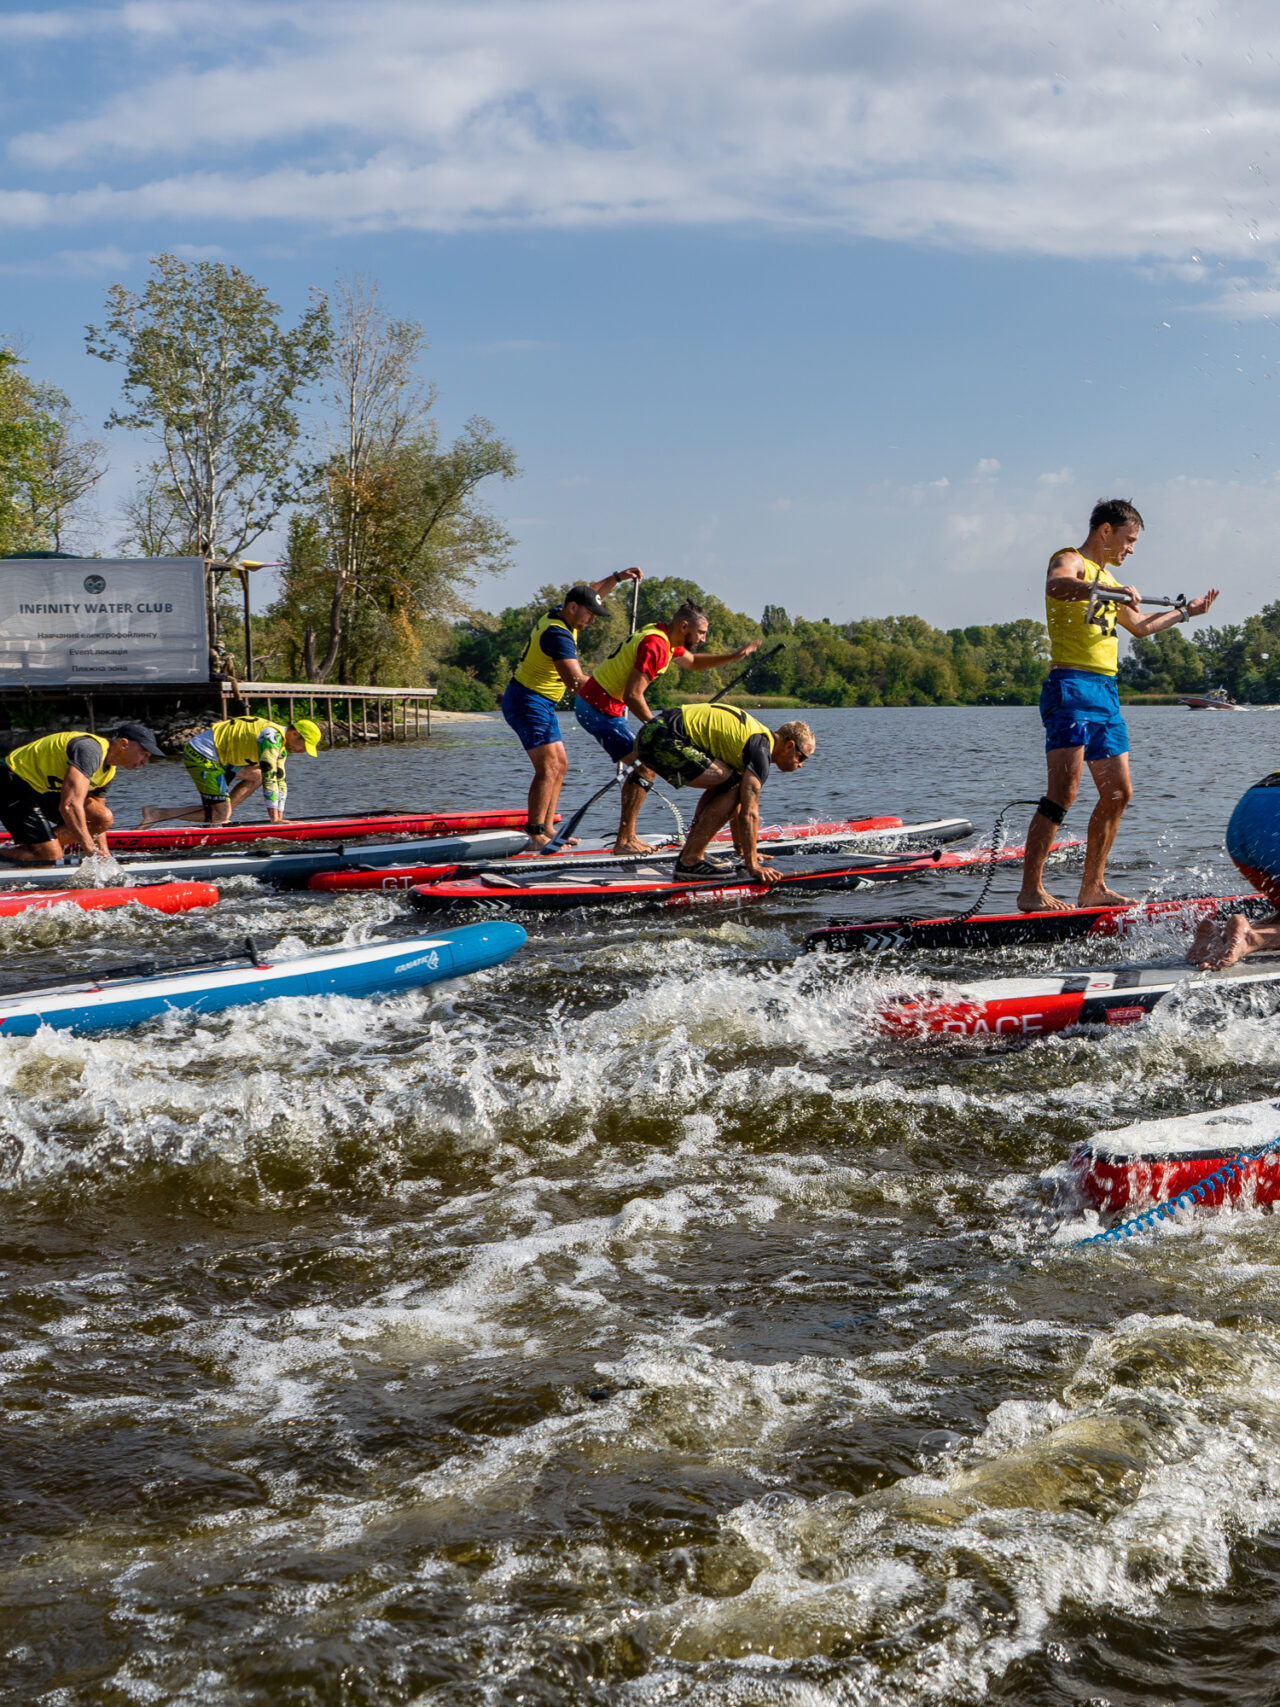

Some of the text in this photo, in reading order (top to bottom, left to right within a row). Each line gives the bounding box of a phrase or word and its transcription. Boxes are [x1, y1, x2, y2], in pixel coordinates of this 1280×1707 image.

[19, 602, 174, 614] INFINITY WATER CLUB
[382, 876, 413, 890] GT
